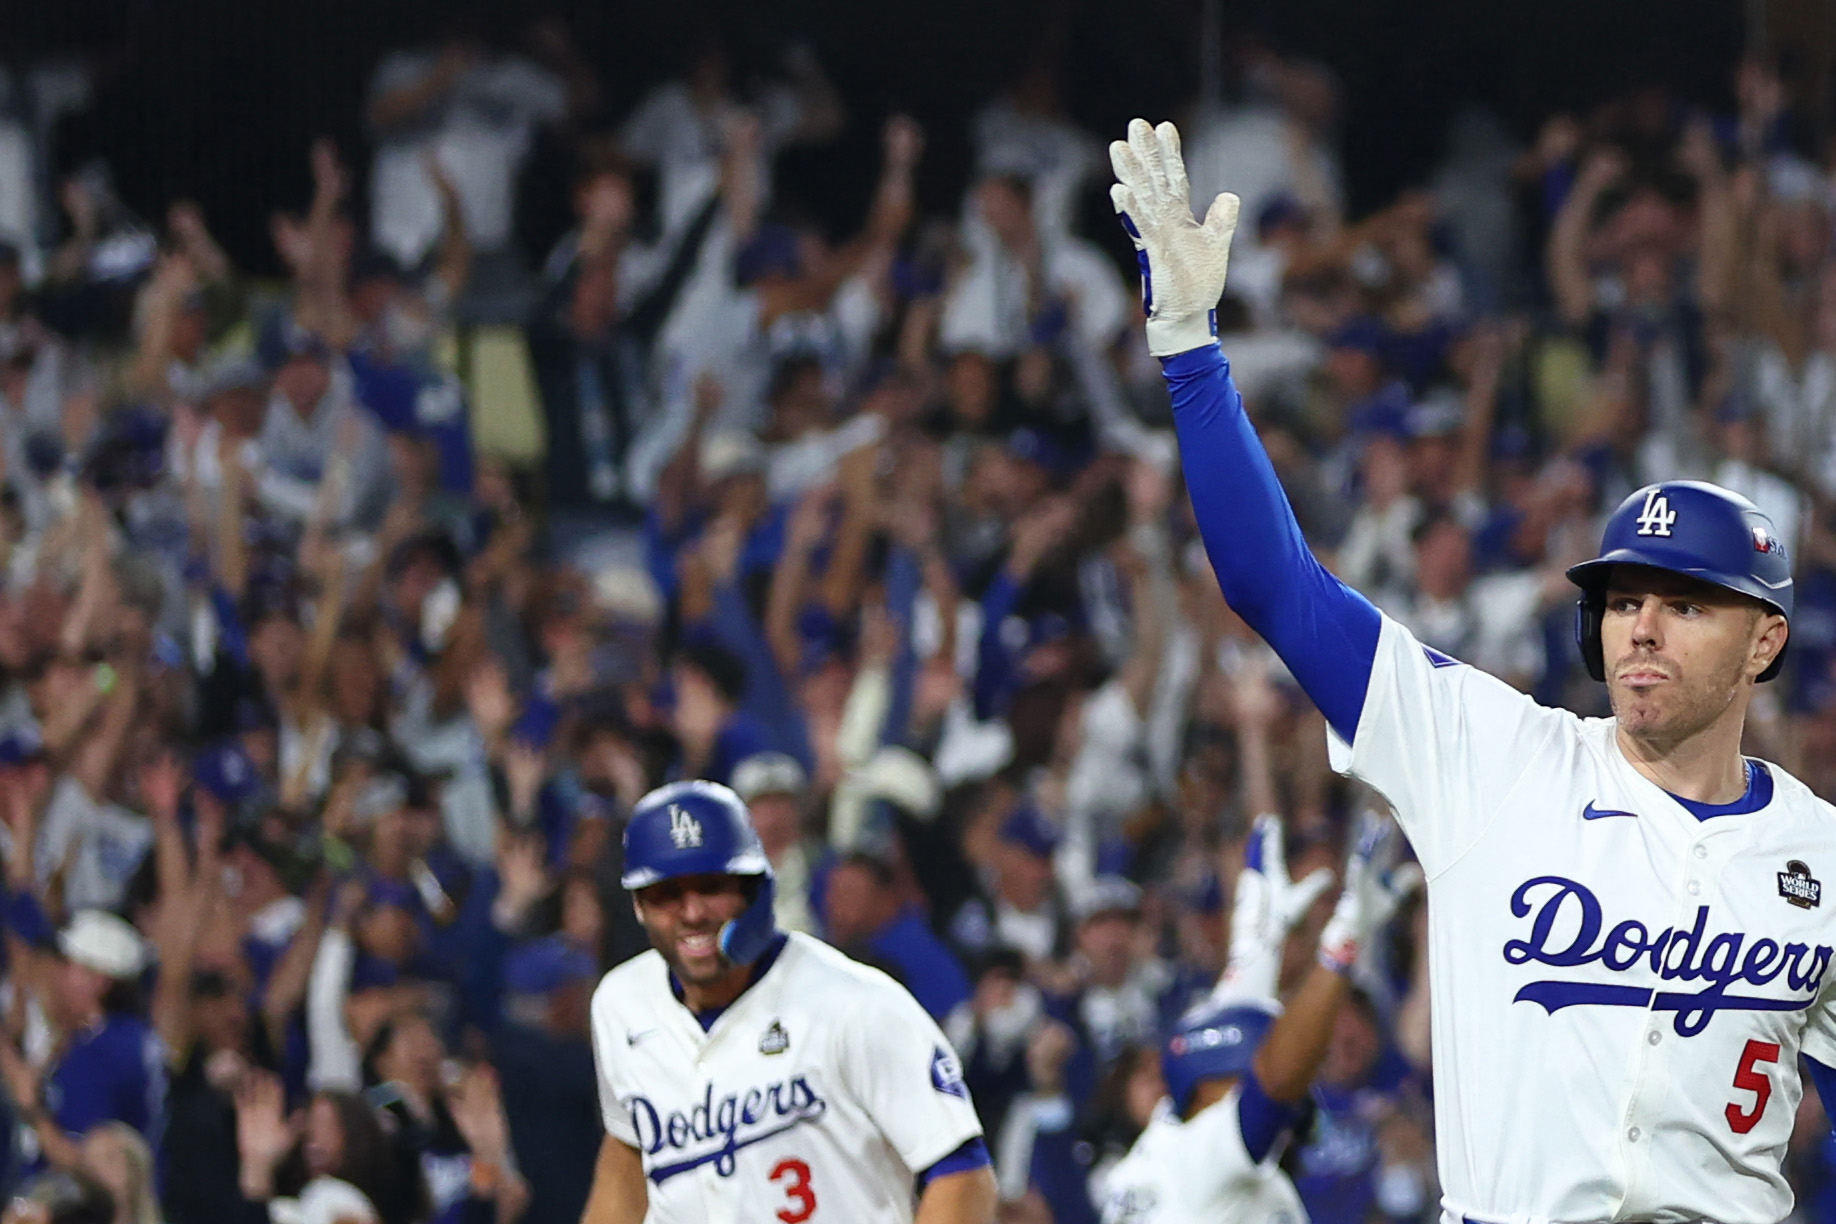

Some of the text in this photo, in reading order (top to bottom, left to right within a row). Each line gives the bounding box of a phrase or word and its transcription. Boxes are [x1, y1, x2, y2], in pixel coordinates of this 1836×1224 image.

[1636, 488, 1676, 537] LA
[668, 803, 704, 849] LA
[1780, 874, 1819, 892] WORLD
[1782, 883, 1818, 901] SERIES
[1503, 875, 1835, 1038] Dodgers
[1724, 1038, 1781, 1134] 5
[628, 1076, 826, 1178] Dodgers
